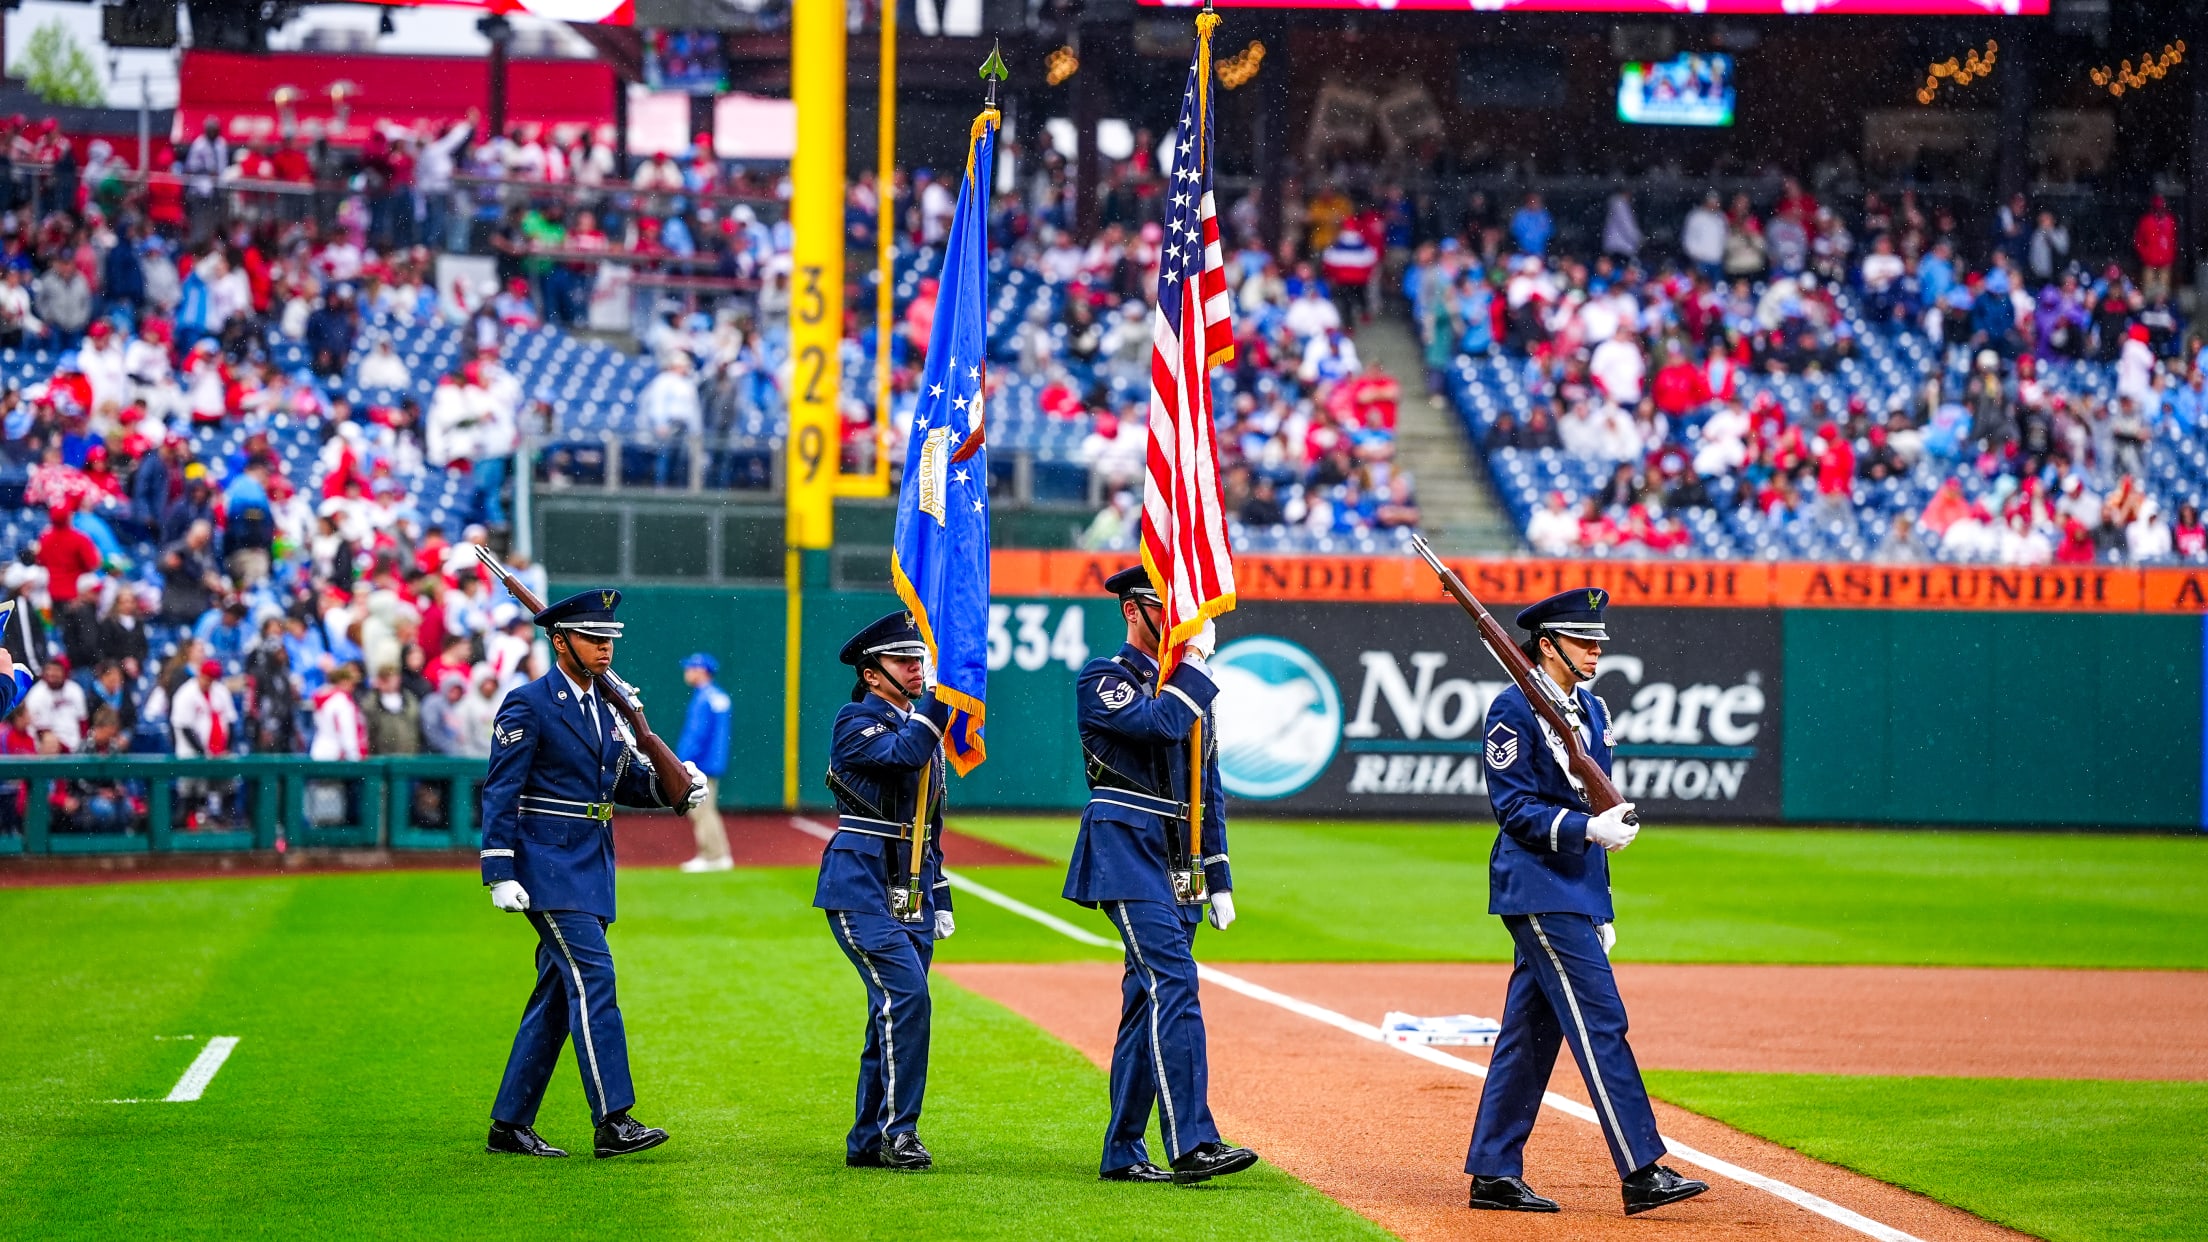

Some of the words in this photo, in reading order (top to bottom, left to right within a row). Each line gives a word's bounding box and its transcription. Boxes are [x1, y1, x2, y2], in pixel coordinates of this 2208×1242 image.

[799, 266, 825, 483] 329
[922, 478, 938, 511] STAT
[1804, 566, 2110, 602] ASPLUNDH
[987, 603, 1090, 671] 334
[1344, 650, 1766, 746] NoCare
[1347, 755, 1749, 801] REHAATION
